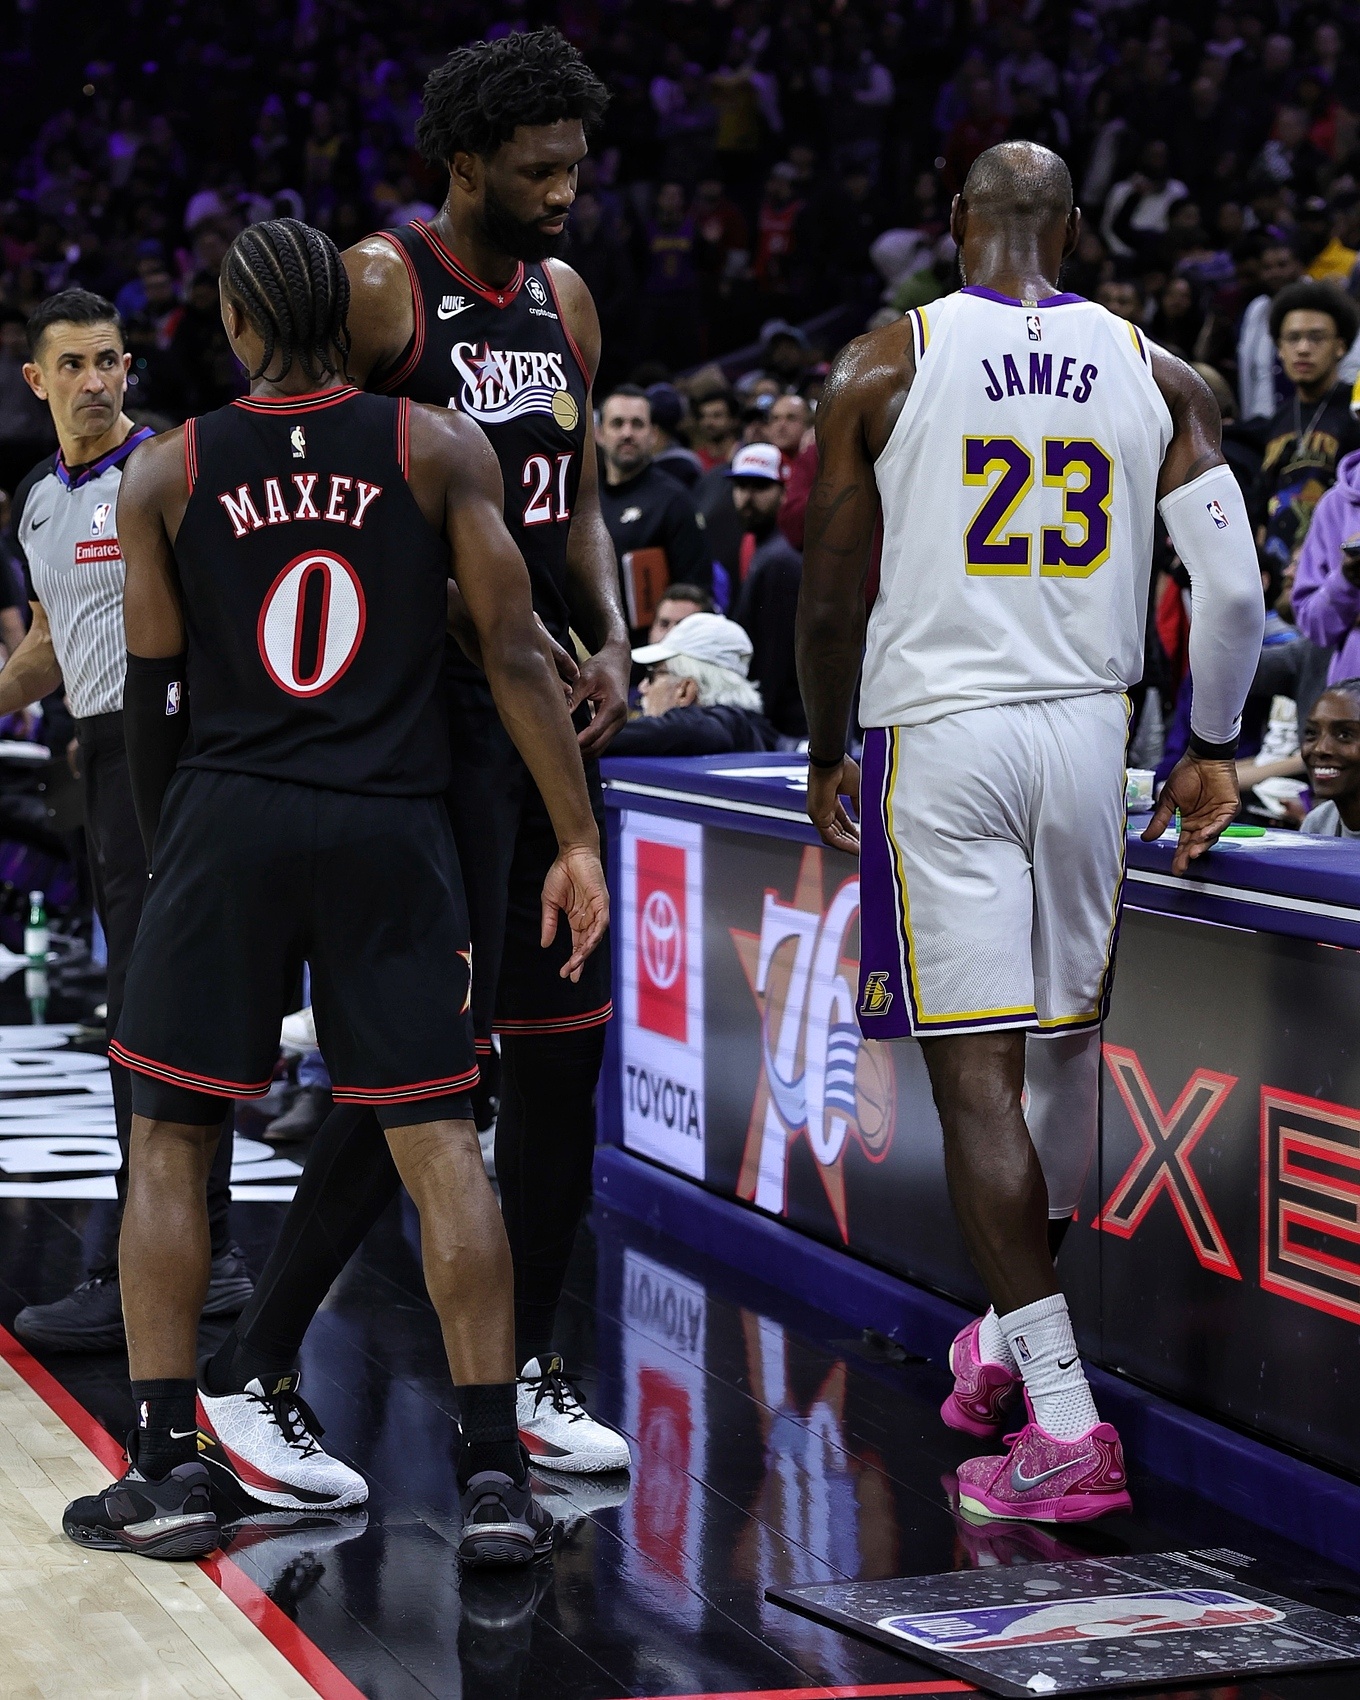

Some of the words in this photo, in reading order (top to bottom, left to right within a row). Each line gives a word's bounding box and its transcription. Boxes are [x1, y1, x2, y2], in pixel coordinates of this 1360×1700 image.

[441, 295, 465, 310] NIKE
[528, 307, 559, 320] crypto.com
[981, 352, 1098, 403] JAMES
[218, 473, 385, 539] MAXEY
[522, 451, 575, 527] 21
[962, 435, 1115, 578] 23
[76, 544, 121, 562] Emirates
[257, 549, 367, 699] 0
[626, 1064, 703, 1141] TOYOTA
[1072, 1041, 1360, 1326] XE
[272, 1376, 293, 1395] JE
